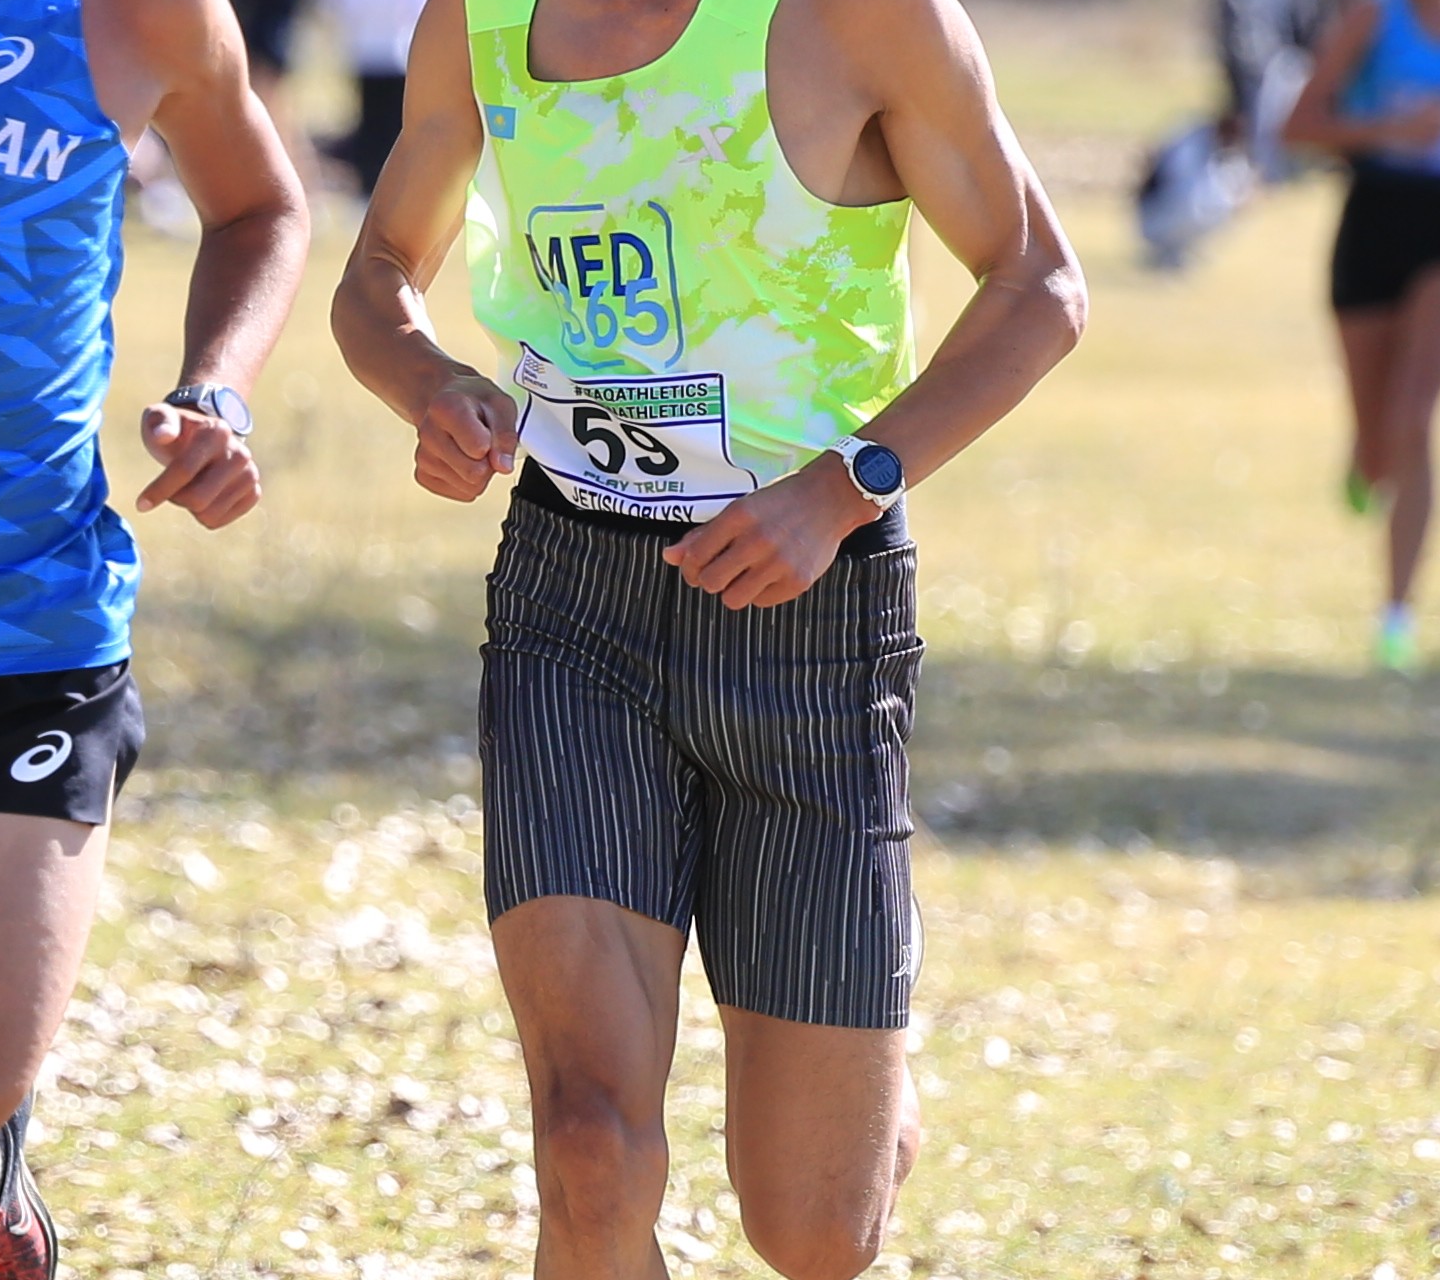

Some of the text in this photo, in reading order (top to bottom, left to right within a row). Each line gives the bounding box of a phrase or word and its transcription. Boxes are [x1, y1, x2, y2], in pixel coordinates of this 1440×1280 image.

[525, 232, 653, 298] MED
[573, 406, 680, 477] 59
[634, 480, 685, 494] TRUE!
